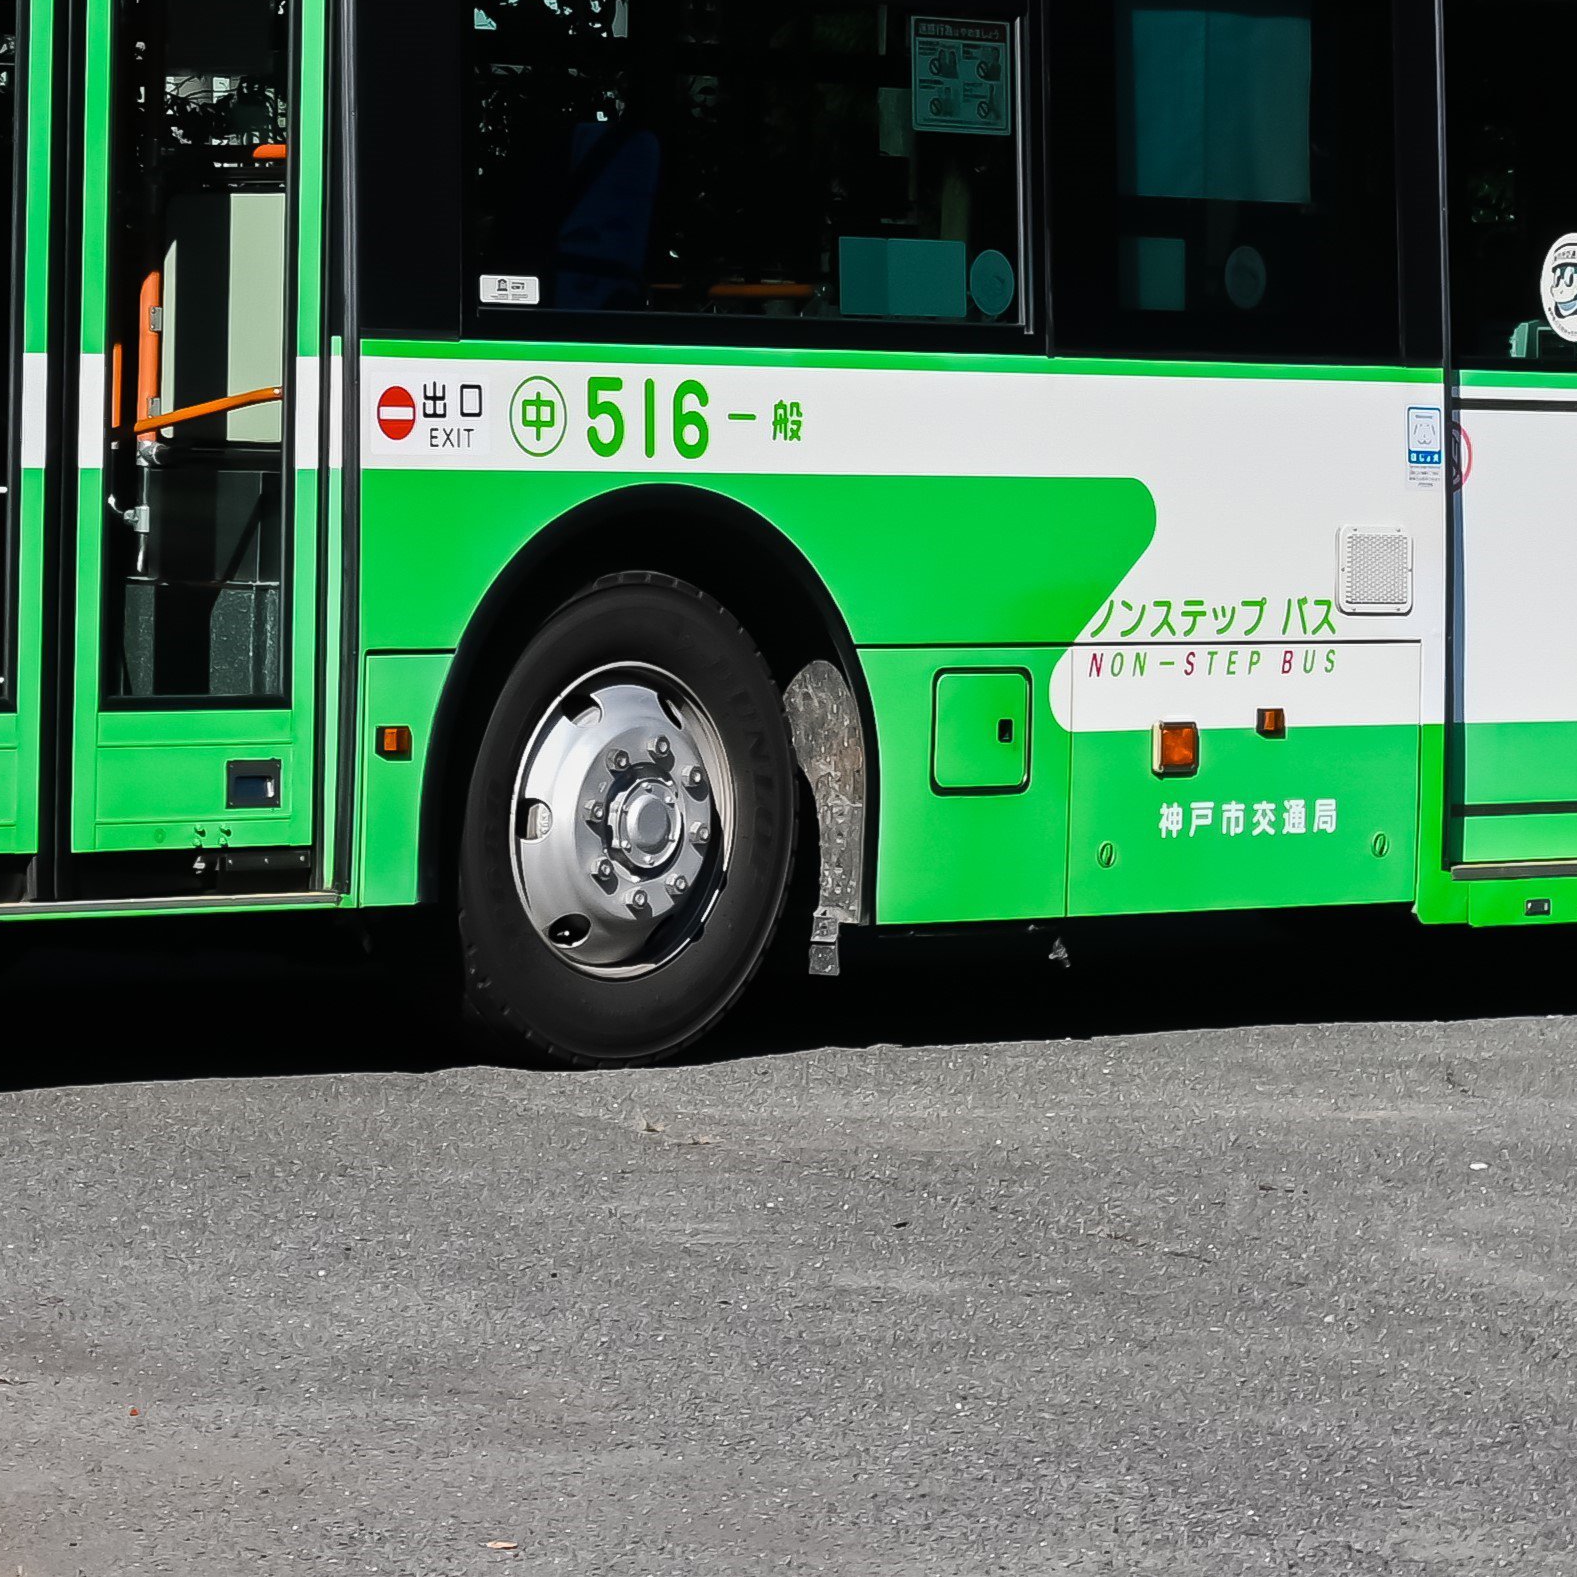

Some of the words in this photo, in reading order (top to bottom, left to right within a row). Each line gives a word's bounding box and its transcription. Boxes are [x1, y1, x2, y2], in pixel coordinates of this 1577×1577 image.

[422, 380, 484, 420] 出口
[586, 376, 711, 460] 516
[727, 399, 804, 443] 一般
[428, 427, 475, 449] EXIT
[1089, 596, 1268, 638] ノンステップ
[1281, 595, 1337, 636] バス
[1087, 649, 1261, 678] NON-STEP
[1281, 648, 1338, 675] BUS
[1157, 797, 1338, 839] 神戸市交通局
